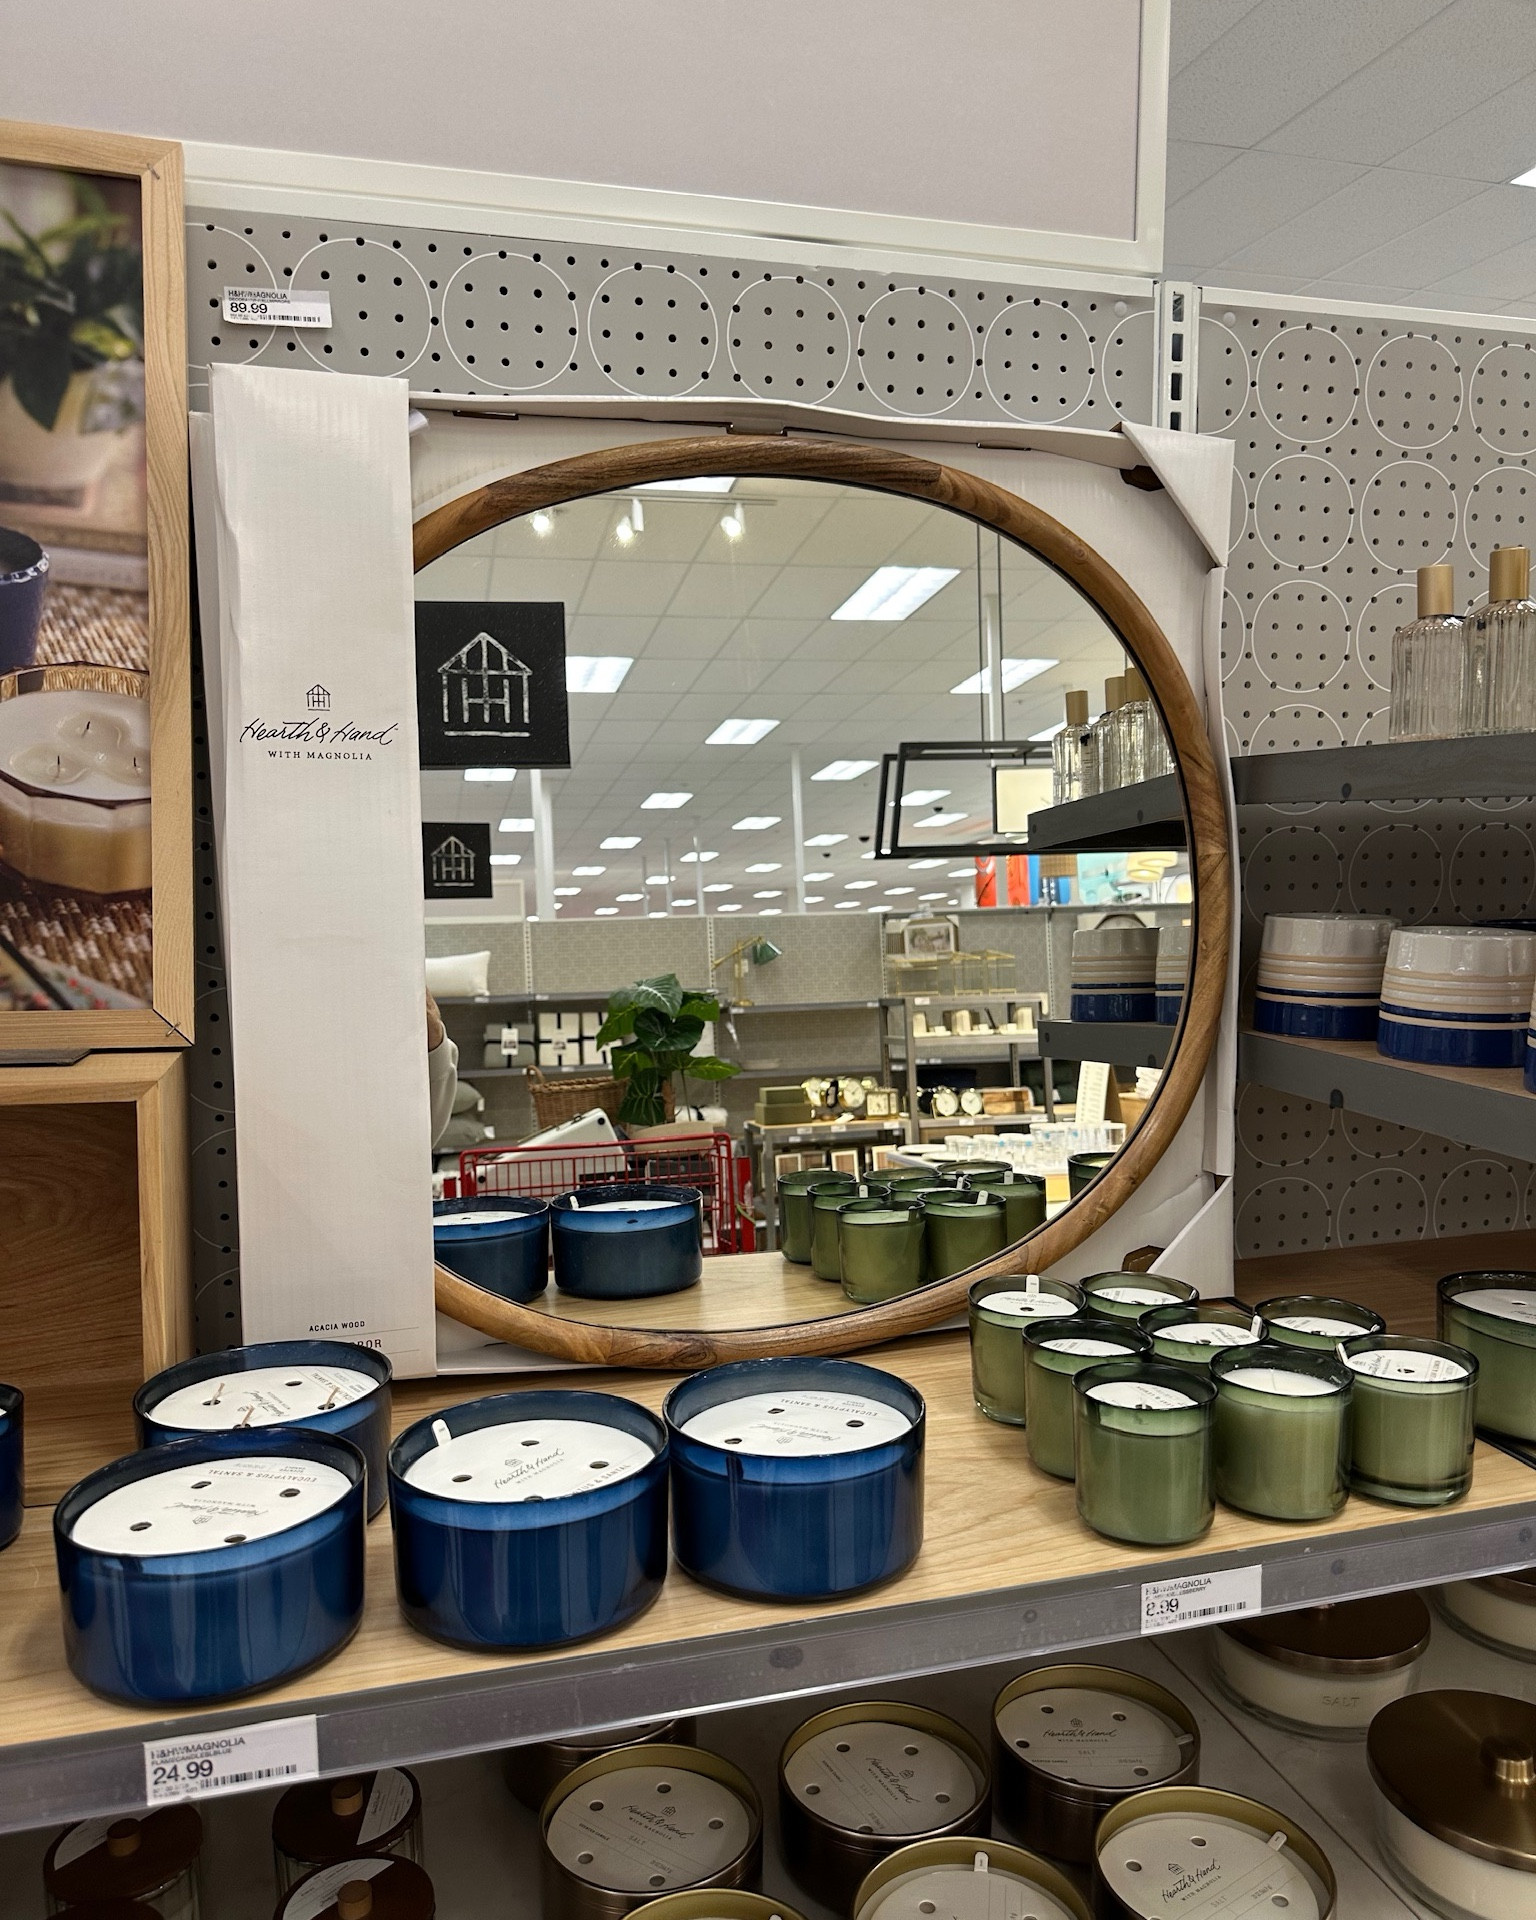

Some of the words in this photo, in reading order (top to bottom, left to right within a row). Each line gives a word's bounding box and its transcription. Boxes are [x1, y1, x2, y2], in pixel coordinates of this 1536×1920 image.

[230, 302, 268, 313] 89.99
[239, 717, 320, 743] Hearth
[315, 722, 331, 743] &
[330, 721, 398, 745] Hand
[268, 750, 301, 759] WITH
[307, 751, 372, 760] MAGNOLIA
[309, 1323, 339, 1332] ACACIA
[342, 1320, 366, 1329] WOOD
[153, 1759, 213, 1786] 24.99
